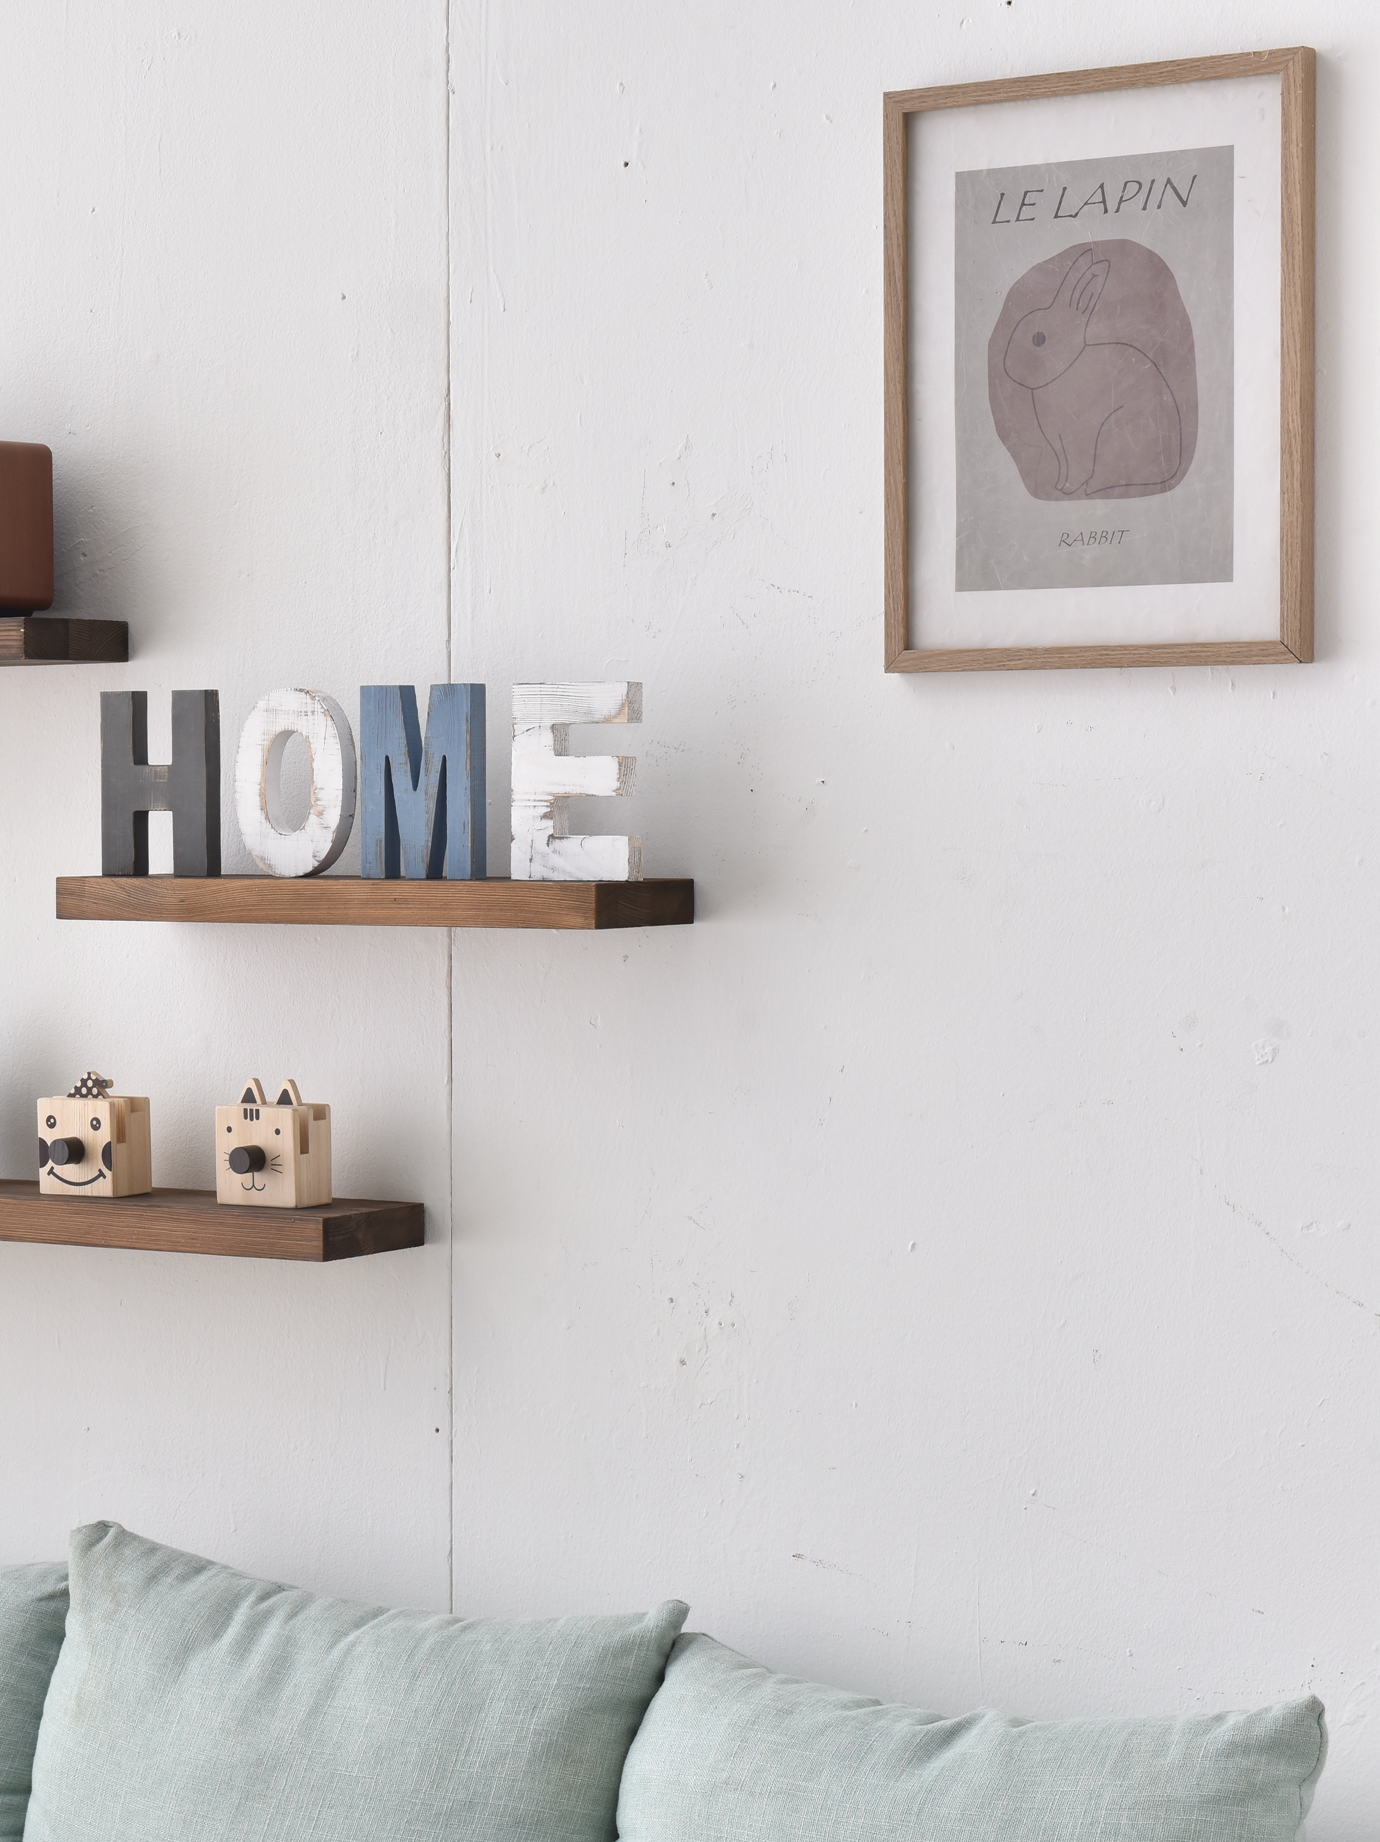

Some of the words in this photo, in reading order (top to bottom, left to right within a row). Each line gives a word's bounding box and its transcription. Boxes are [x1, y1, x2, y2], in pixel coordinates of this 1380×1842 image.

[991, 188, 1045, 225] LE
[1053, 174, 1198, 219] LAPIN
[1058, 529, 1130, 547] RABBIT
[100, 681, 643, 881] HOME
